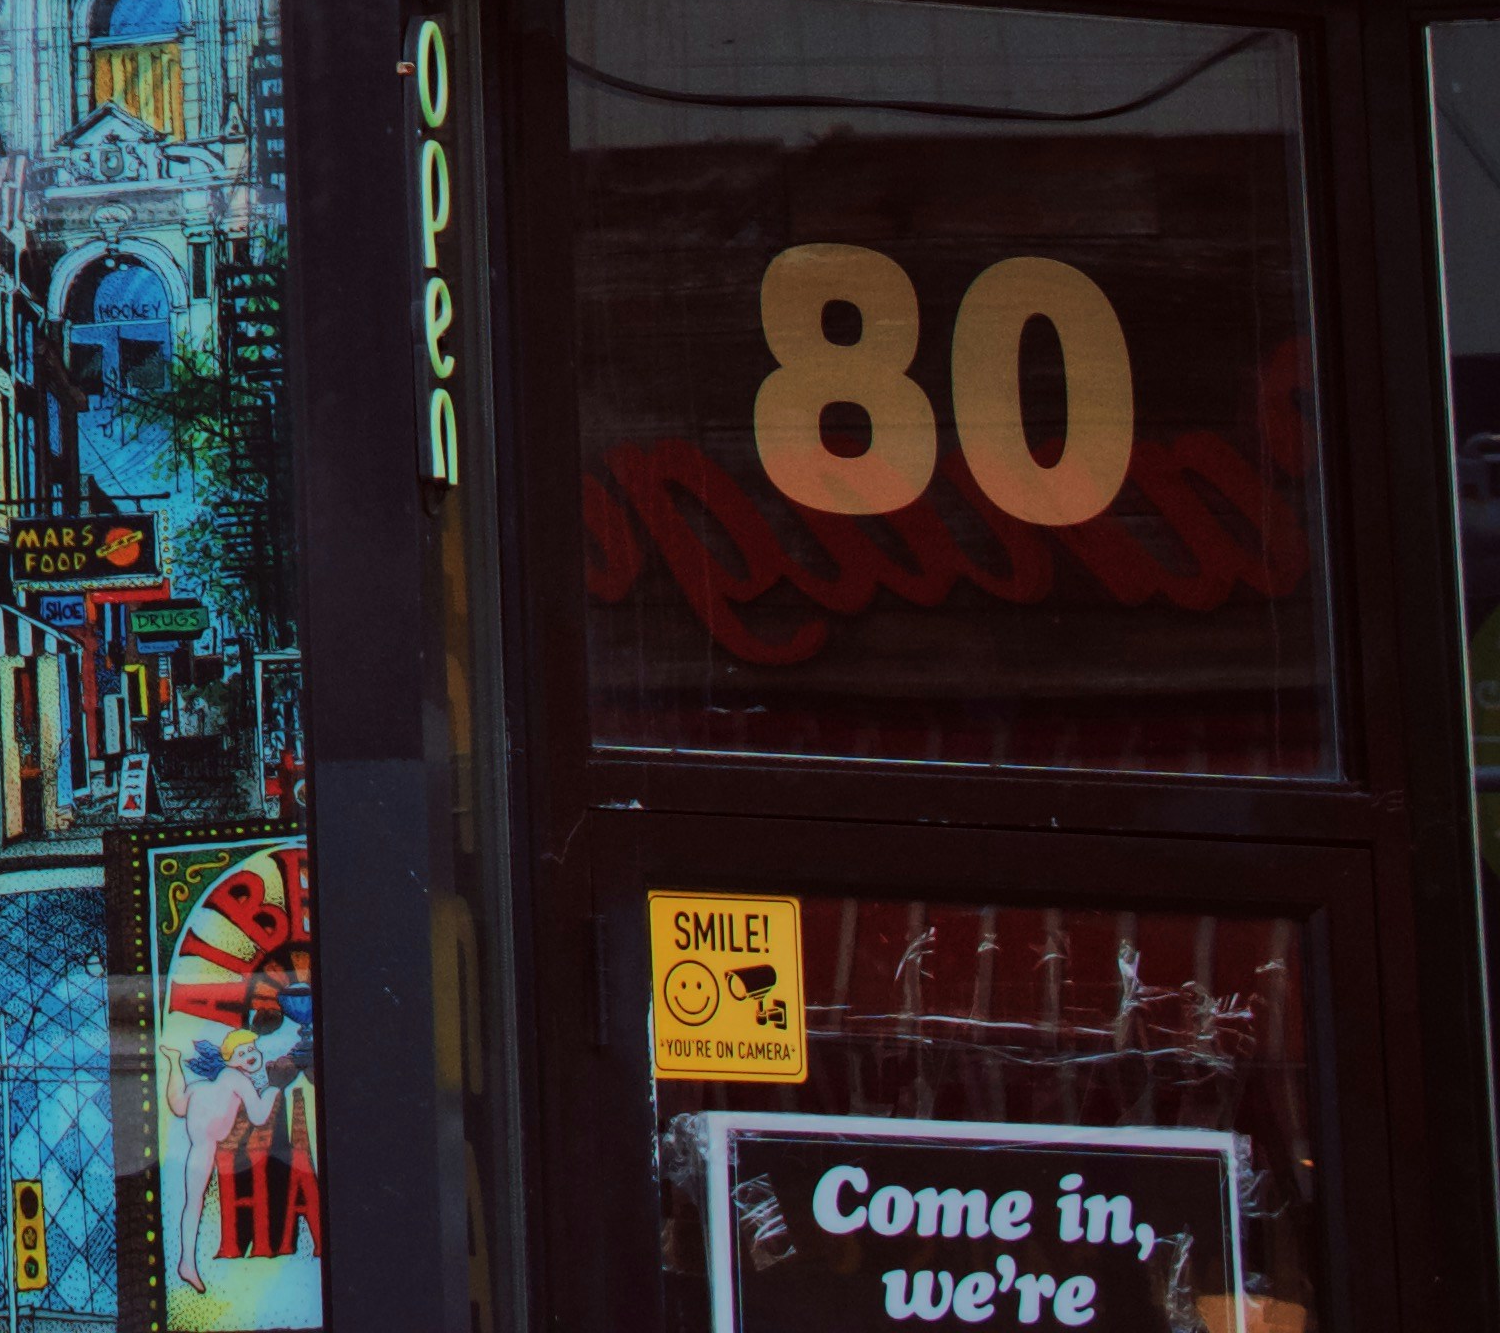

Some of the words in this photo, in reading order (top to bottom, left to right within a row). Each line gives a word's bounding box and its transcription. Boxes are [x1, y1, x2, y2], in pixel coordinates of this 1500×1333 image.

[99, 299, 162, 319] HOCKEY
[752, 241, 1135, 527] 80
[16, 525, 94, 549] MARS
[24, 552, 88, 573] FOOD
[44, 599, 84, 622] SHOE
[136, 611, 201, 629] DRUGS
[673, 910, 770, 954] SMILE!
[665, 1038, 712, 1059] YOU'RE
[716, 1041, 734, 1059] ON
[738, 1041, 791, 1061] CAMERA
[812, 1164, 1034, 1241] Come
[1056, 1172, 1156, 1262] in,
[881, 1253, 1098, 1327] we're
